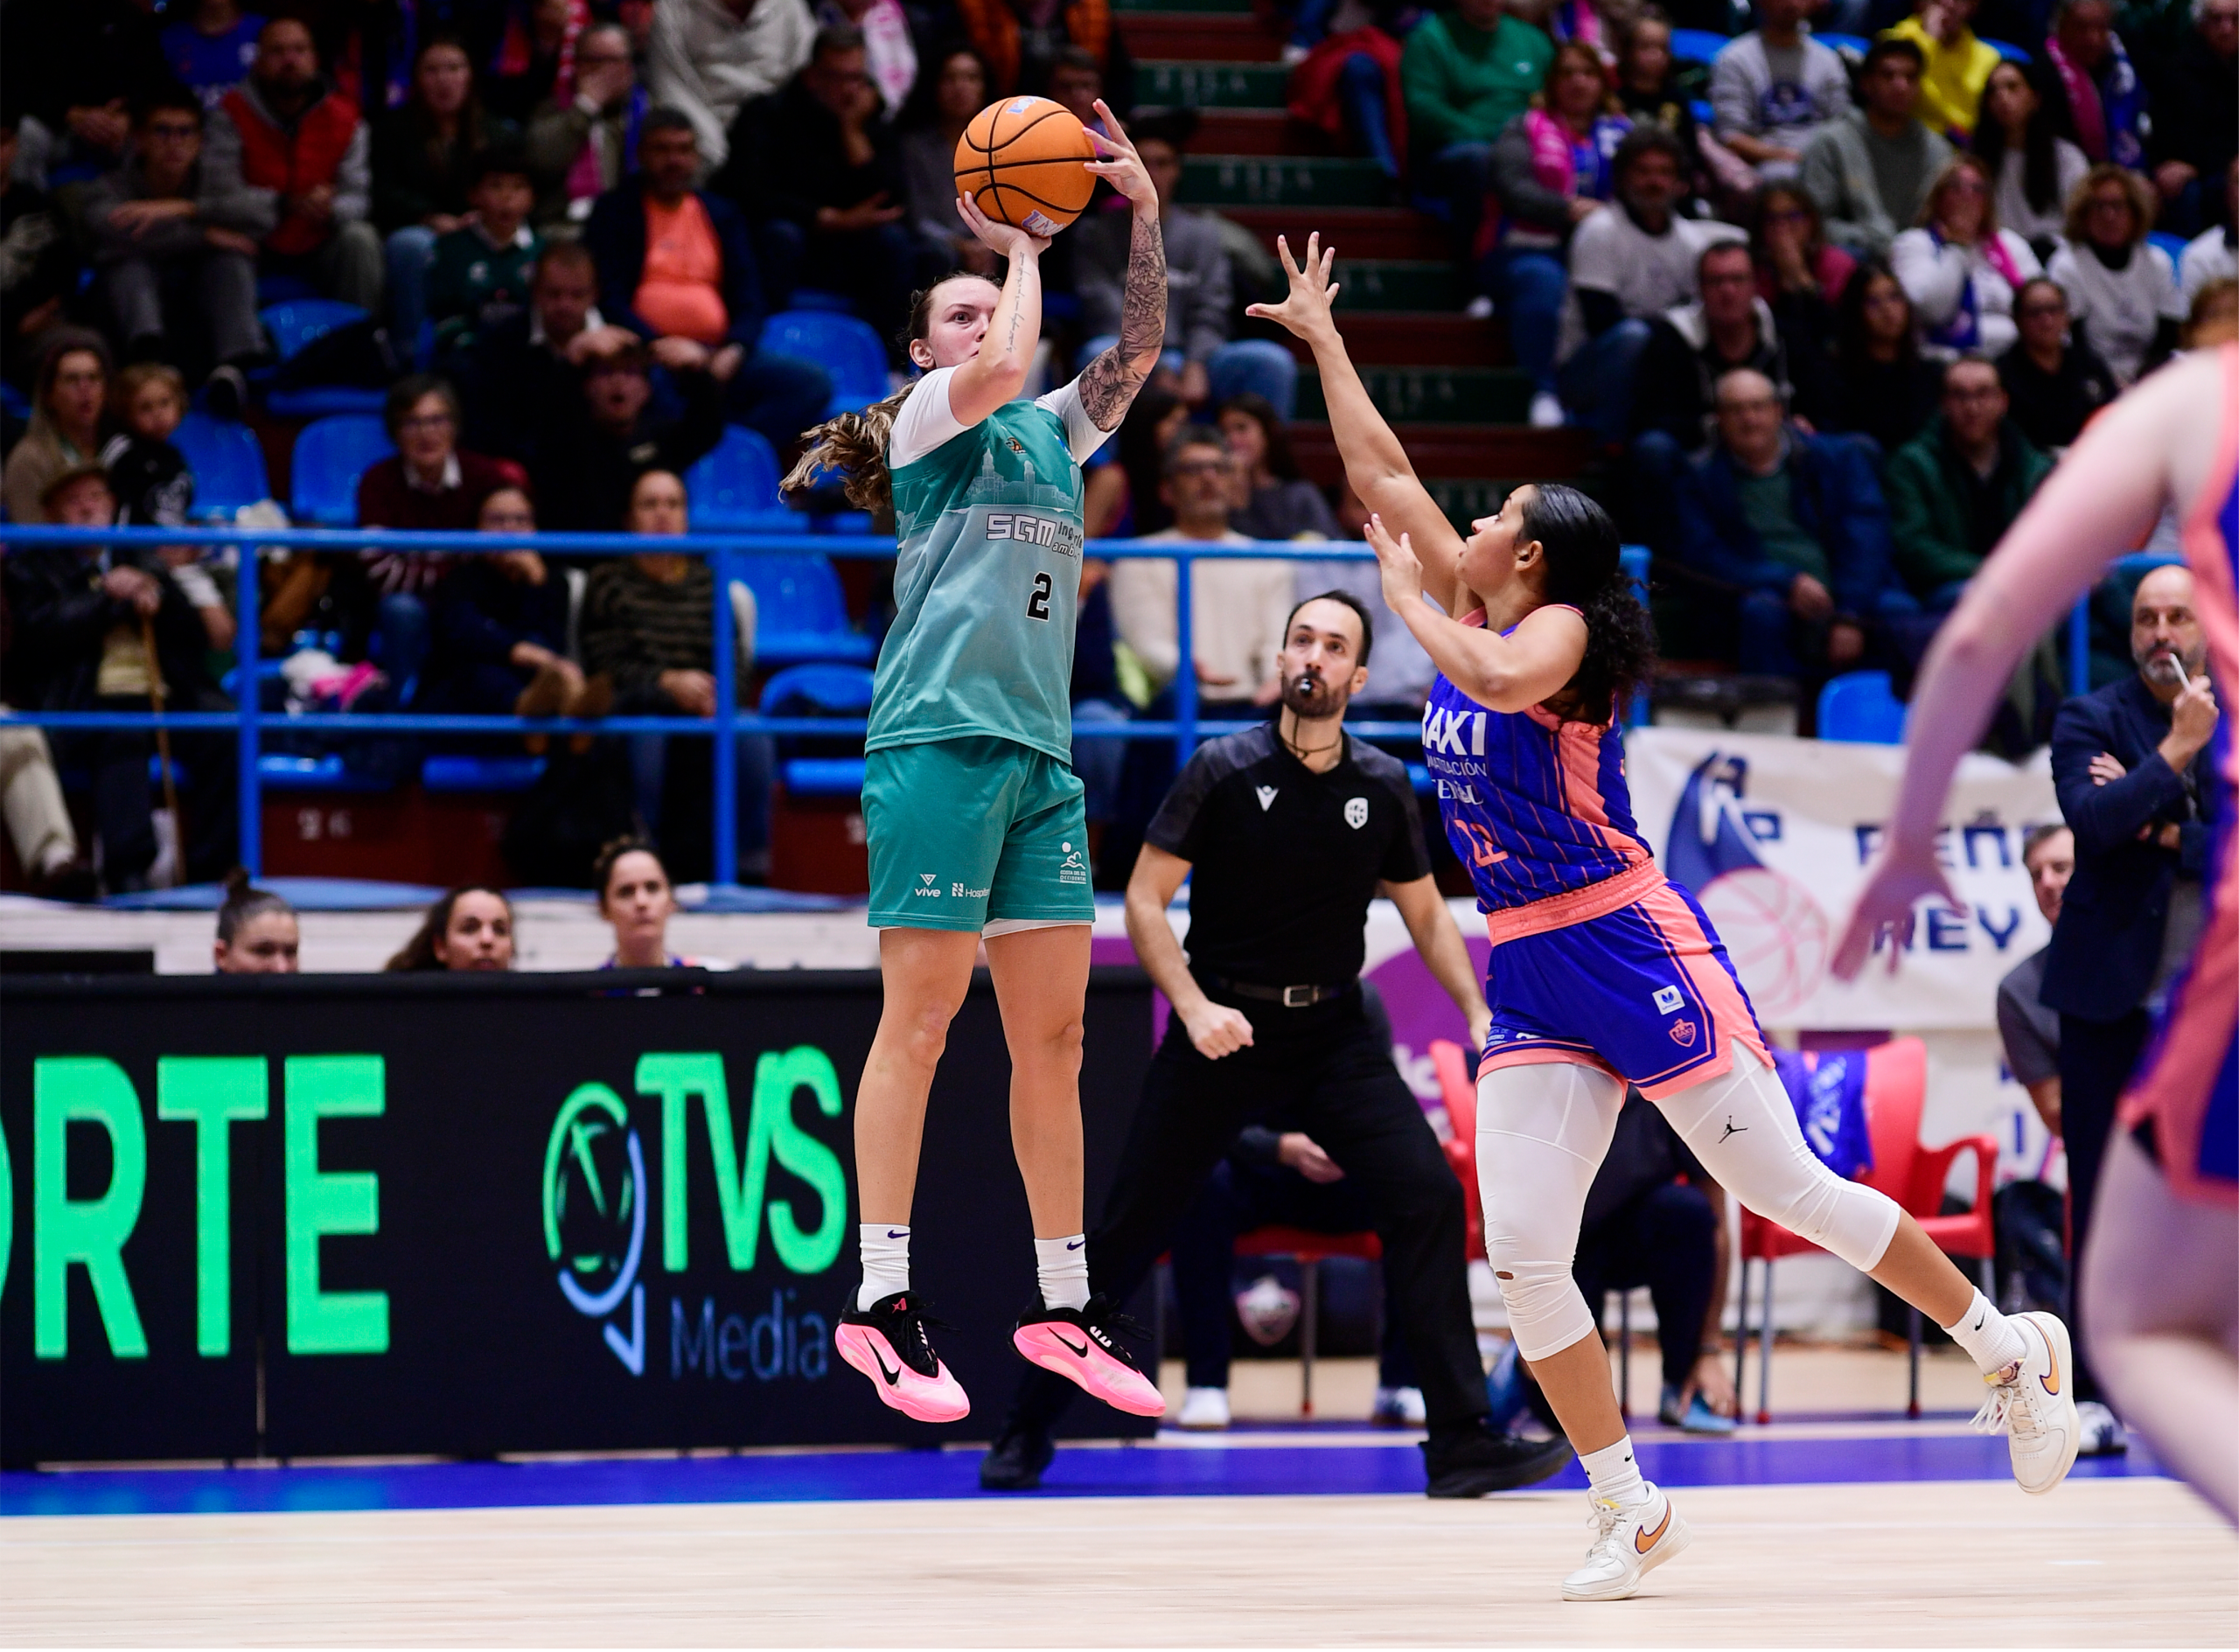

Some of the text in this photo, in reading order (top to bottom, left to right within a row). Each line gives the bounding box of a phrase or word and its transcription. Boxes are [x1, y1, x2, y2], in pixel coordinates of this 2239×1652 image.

[987, 513, 1057, 547] SGM
[1026, 571, 1053, 622] 2
[914, 887, 941, 898] vive
[634, 1045, 847, 1273] TVS
[0, 1055, 390, 1359] RTE
[671, 1287, 829, 1380] Media
